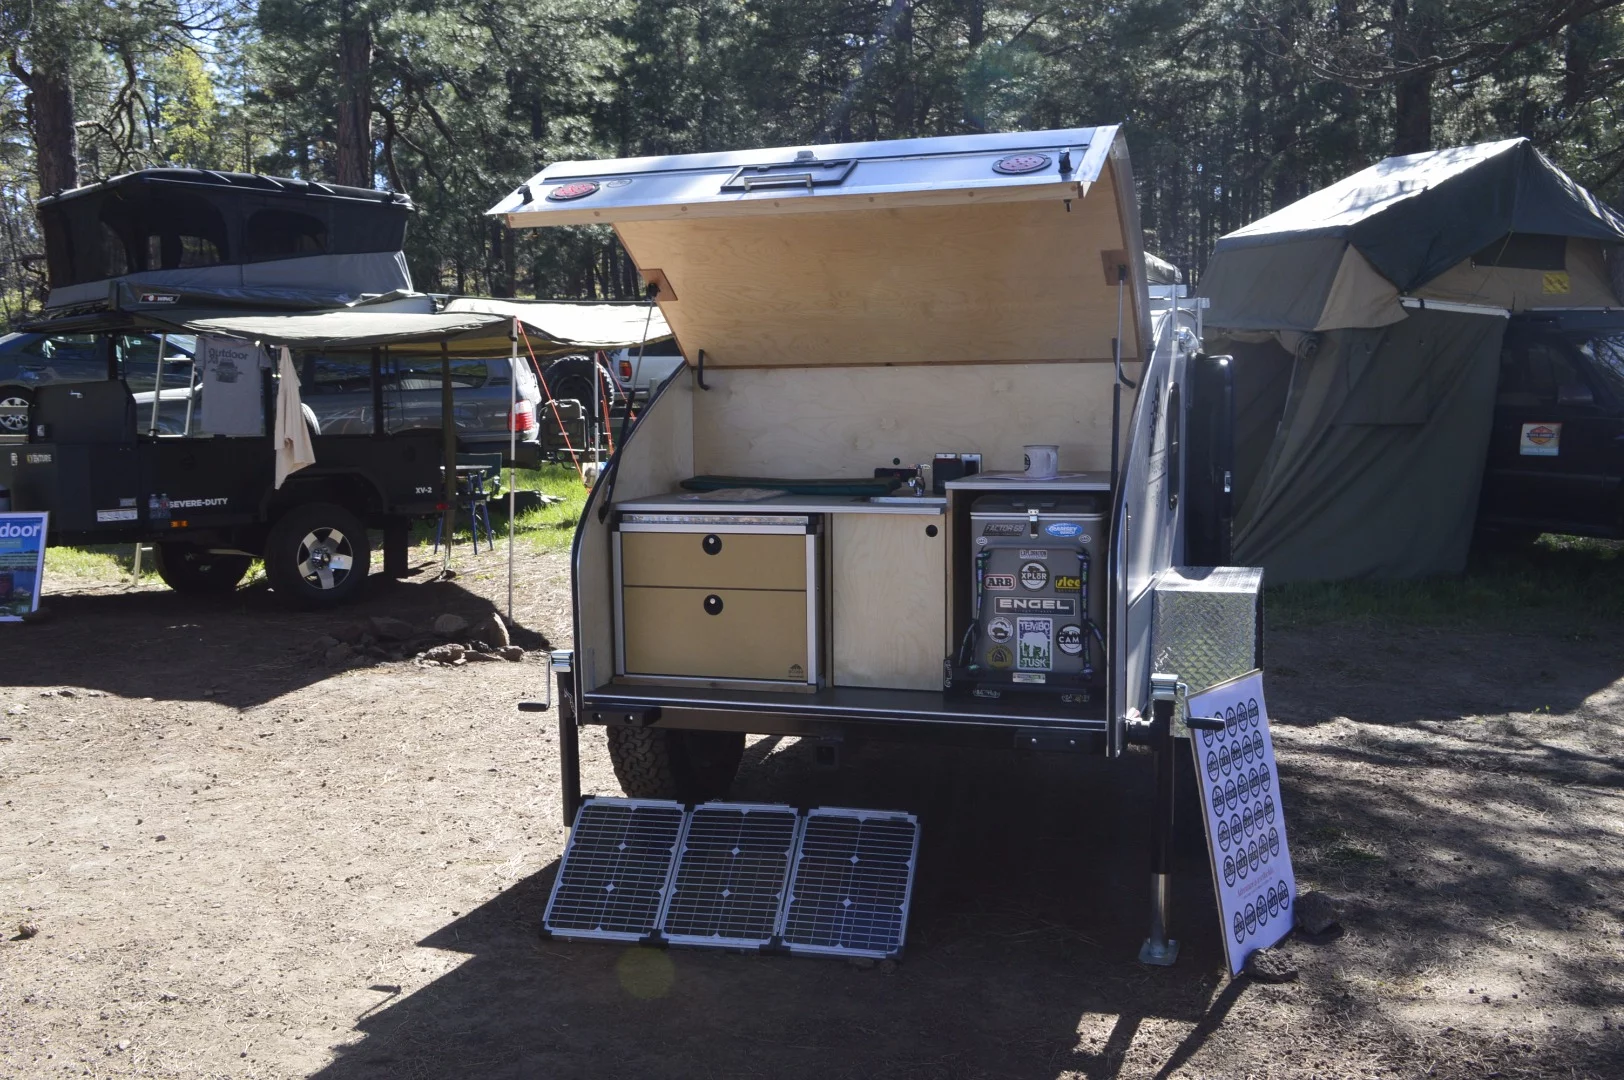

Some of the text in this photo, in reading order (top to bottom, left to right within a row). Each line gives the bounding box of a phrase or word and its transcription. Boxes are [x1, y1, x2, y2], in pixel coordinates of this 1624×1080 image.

[415, 486, 433, 494] XV-2
[169, 498, 229, 509] SEVERE-DUTY
[987, 577, 1013, 587] ARB
[999, 598, 1070, 610] ENGEL
[1019, 621, 1051, 632] TEMBO
[1022, 657, 1048, 668] TUSK
